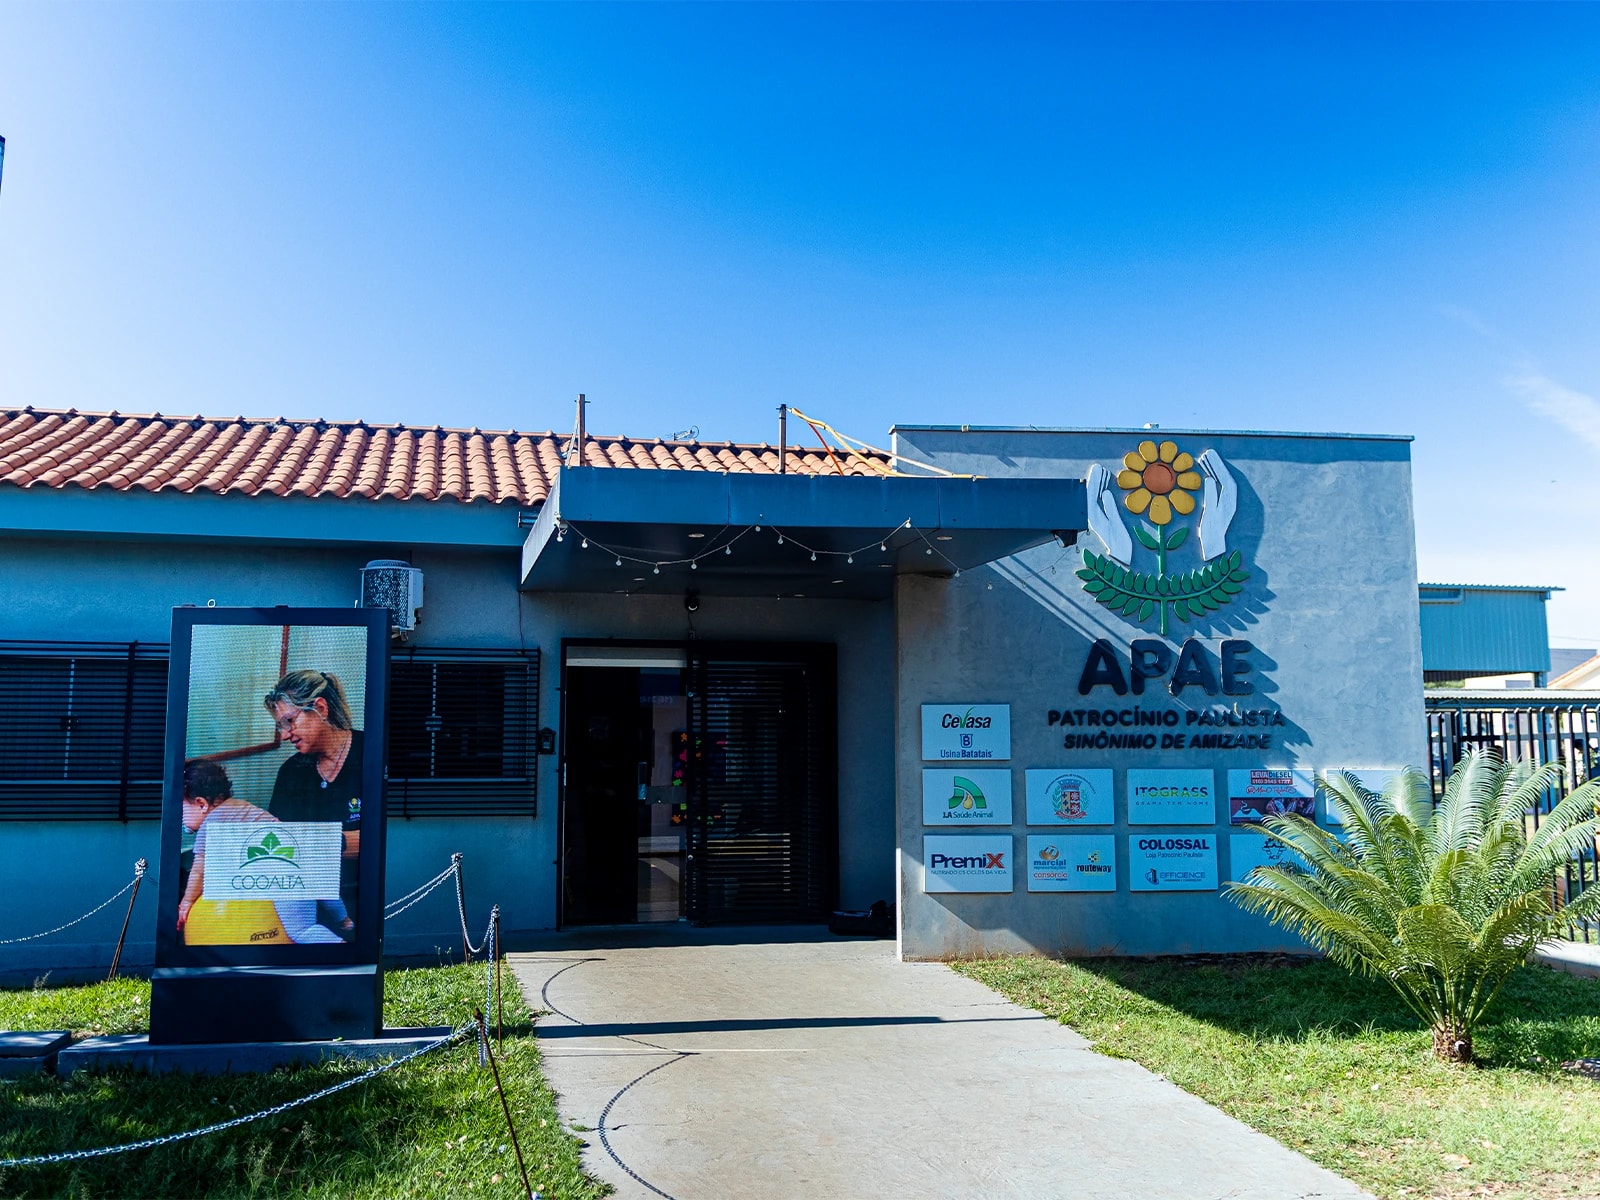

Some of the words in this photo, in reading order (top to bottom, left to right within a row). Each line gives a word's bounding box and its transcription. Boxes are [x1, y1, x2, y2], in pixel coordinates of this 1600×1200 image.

[1078, 638, 1254, 696] APAE
[942, 707, 991, 728] Cevasa
[1047, 705, 1179, 727] PATROCÍNIO
[1186, 709, 1285, 727] PAULISTA
[1064, 731, 1156, 749] SINÔNIMO
[1161, 734, 1186, 749] DE
[1189, 733, 1272, 749] AMIZADE
[940, 749, 960, 758] Usina
[961, 749, 992, 758] Batatais
[1135, 787, 1208, 797] ITOGRASS
[952, 811, 972, 819] Saúde
[972, 811, 993, 819] Animal
[1138, 839, 1210, 851] COLOSSAL
[1076, 864, 1112, 873] routeway
[231, 875, 306, 890] COOALTA
